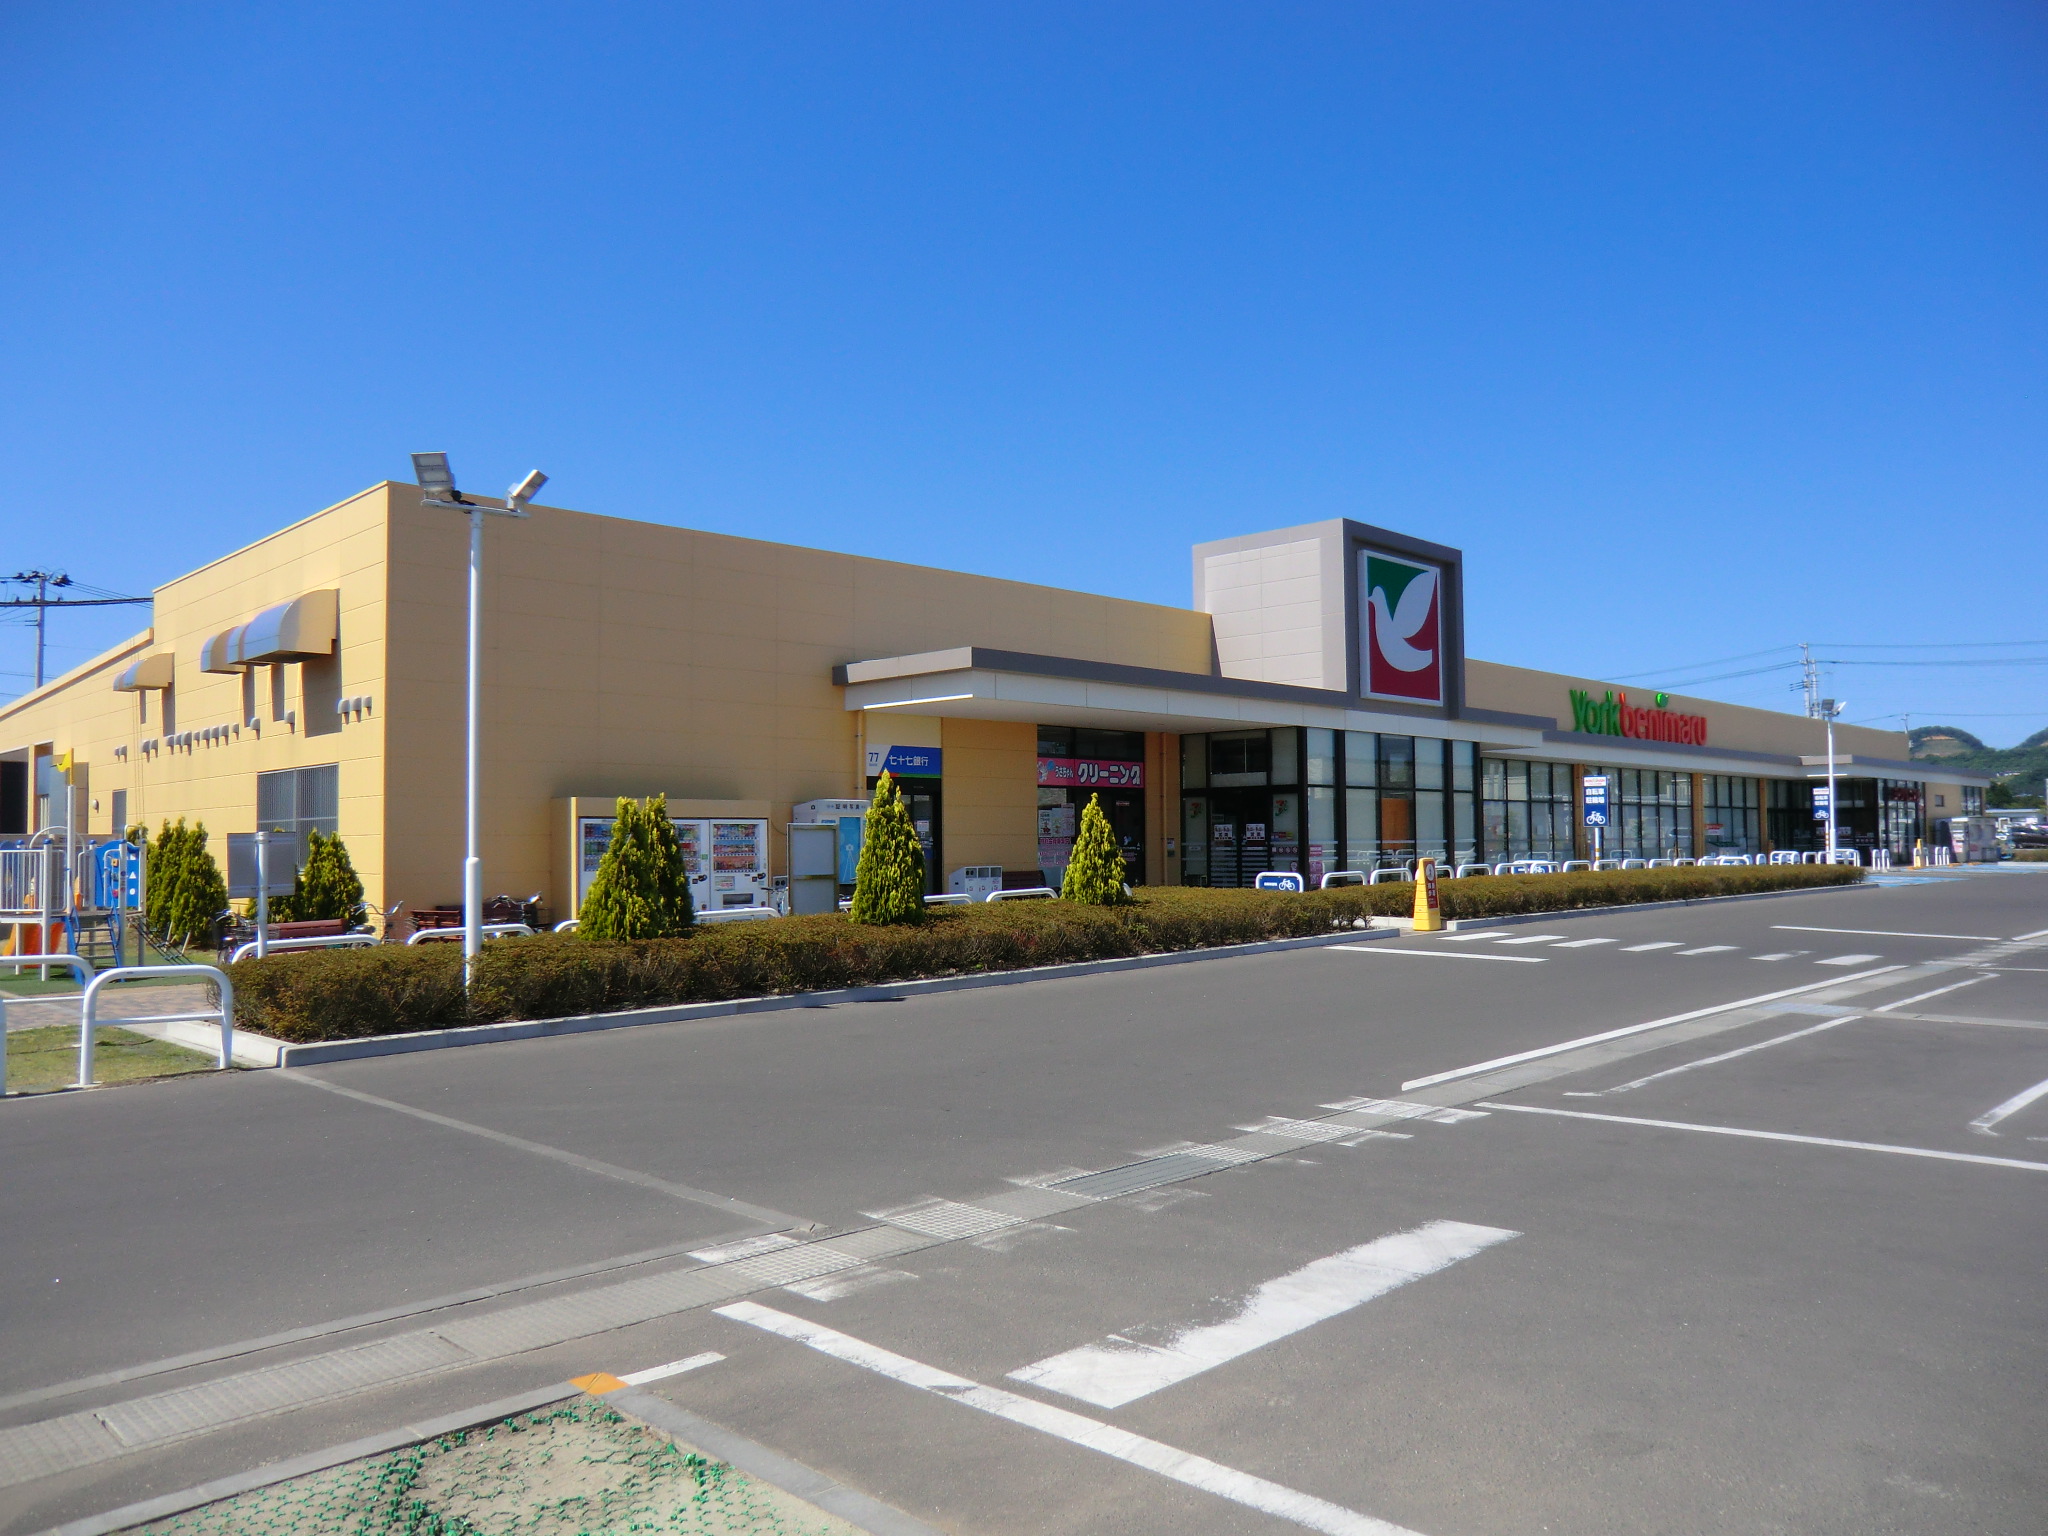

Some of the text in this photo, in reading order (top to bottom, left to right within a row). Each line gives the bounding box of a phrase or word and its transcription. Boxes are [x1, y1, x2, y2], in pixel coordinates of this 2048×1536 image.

[1569, 689, 1707, 746] Yorkbenimaru
[868, 752, 879, 763] 77
[889, 755, 929, 767] 七十七銀行
[1078, 763, 1141, 785] クリーニング
